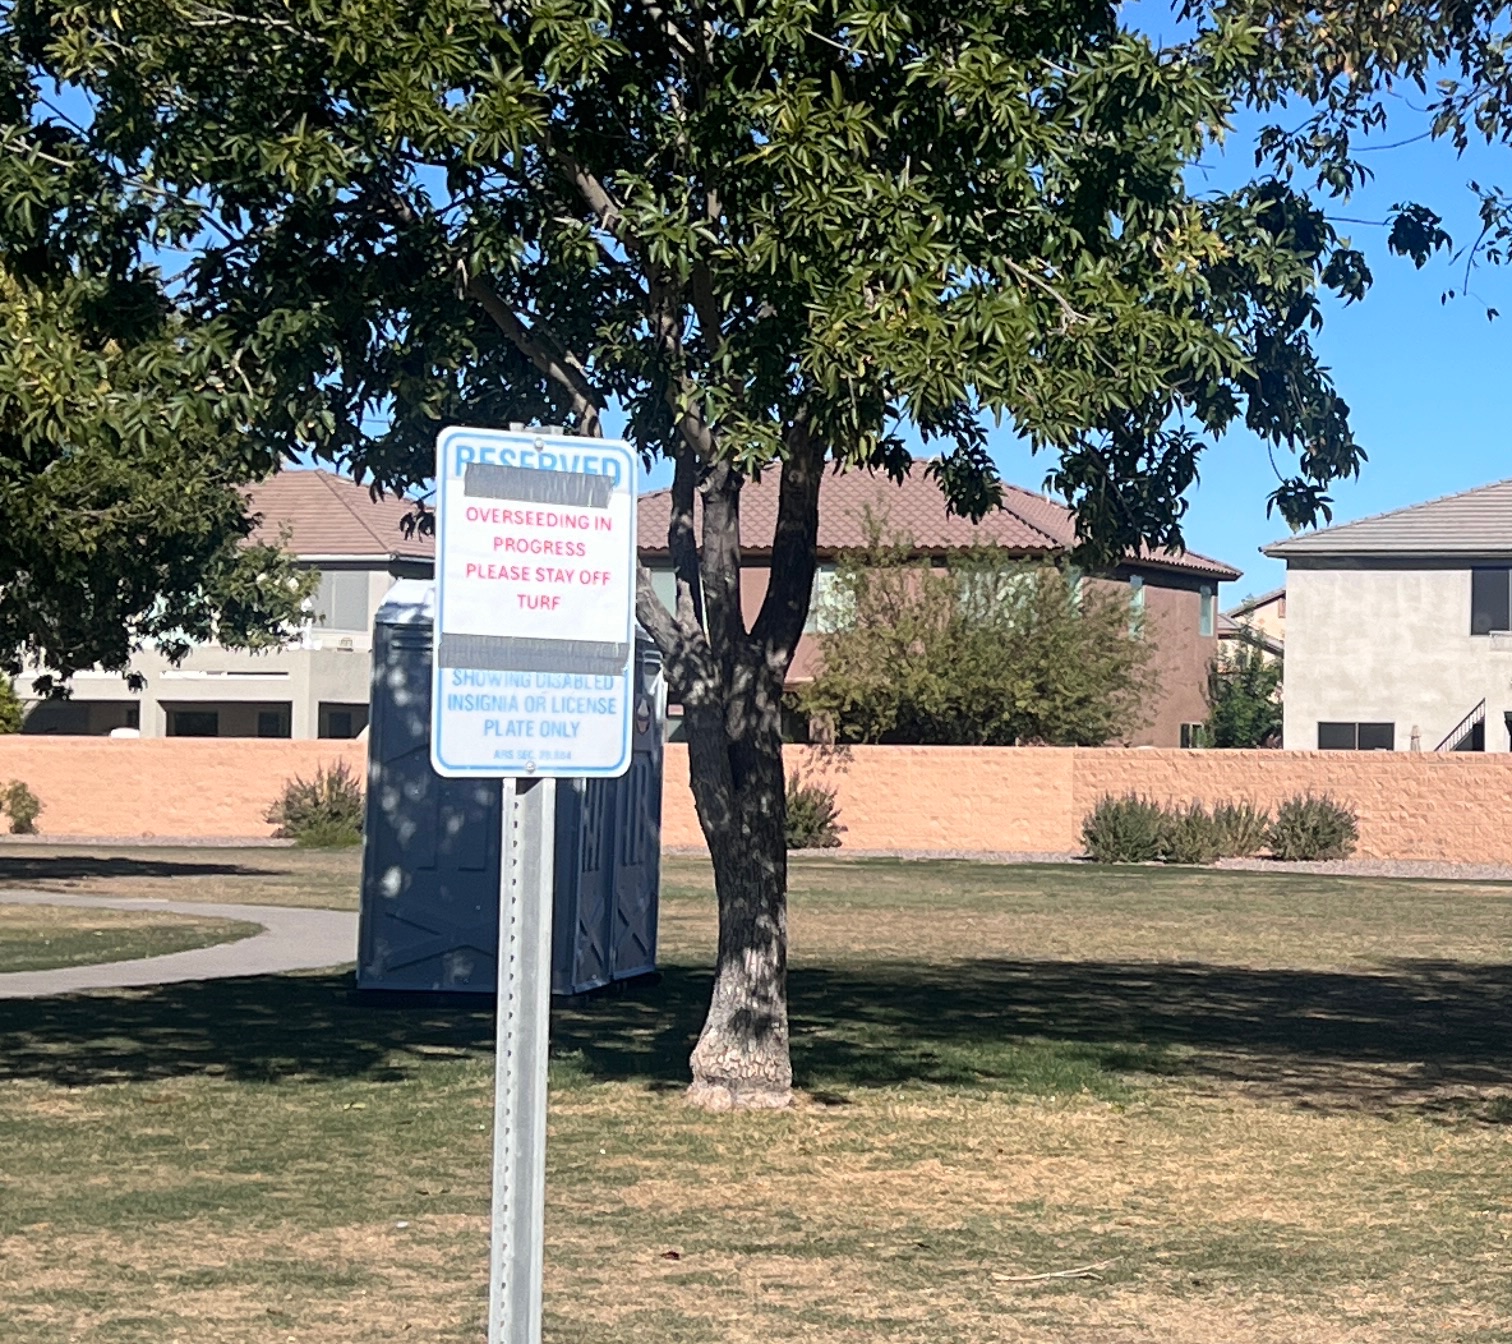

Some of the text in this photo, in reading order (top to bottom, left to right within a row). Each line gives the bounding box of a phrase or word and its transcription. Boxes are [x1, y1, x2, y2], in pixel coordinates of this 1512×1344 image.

[466, 507, 612, 531] OVERSEEDING IN
[493, 537, 585, 557] PROGRESS
[466, 563, 611, 586] PLEASE STAY OFF
[517, 594, 561, 610] TURF
[452, 670, 614, 690] SHOWING DISABLED
[448, 694, 616, 714] INSIGNIA OR LICENSE
[484, 720, 580, 737] PLATE ONLY
